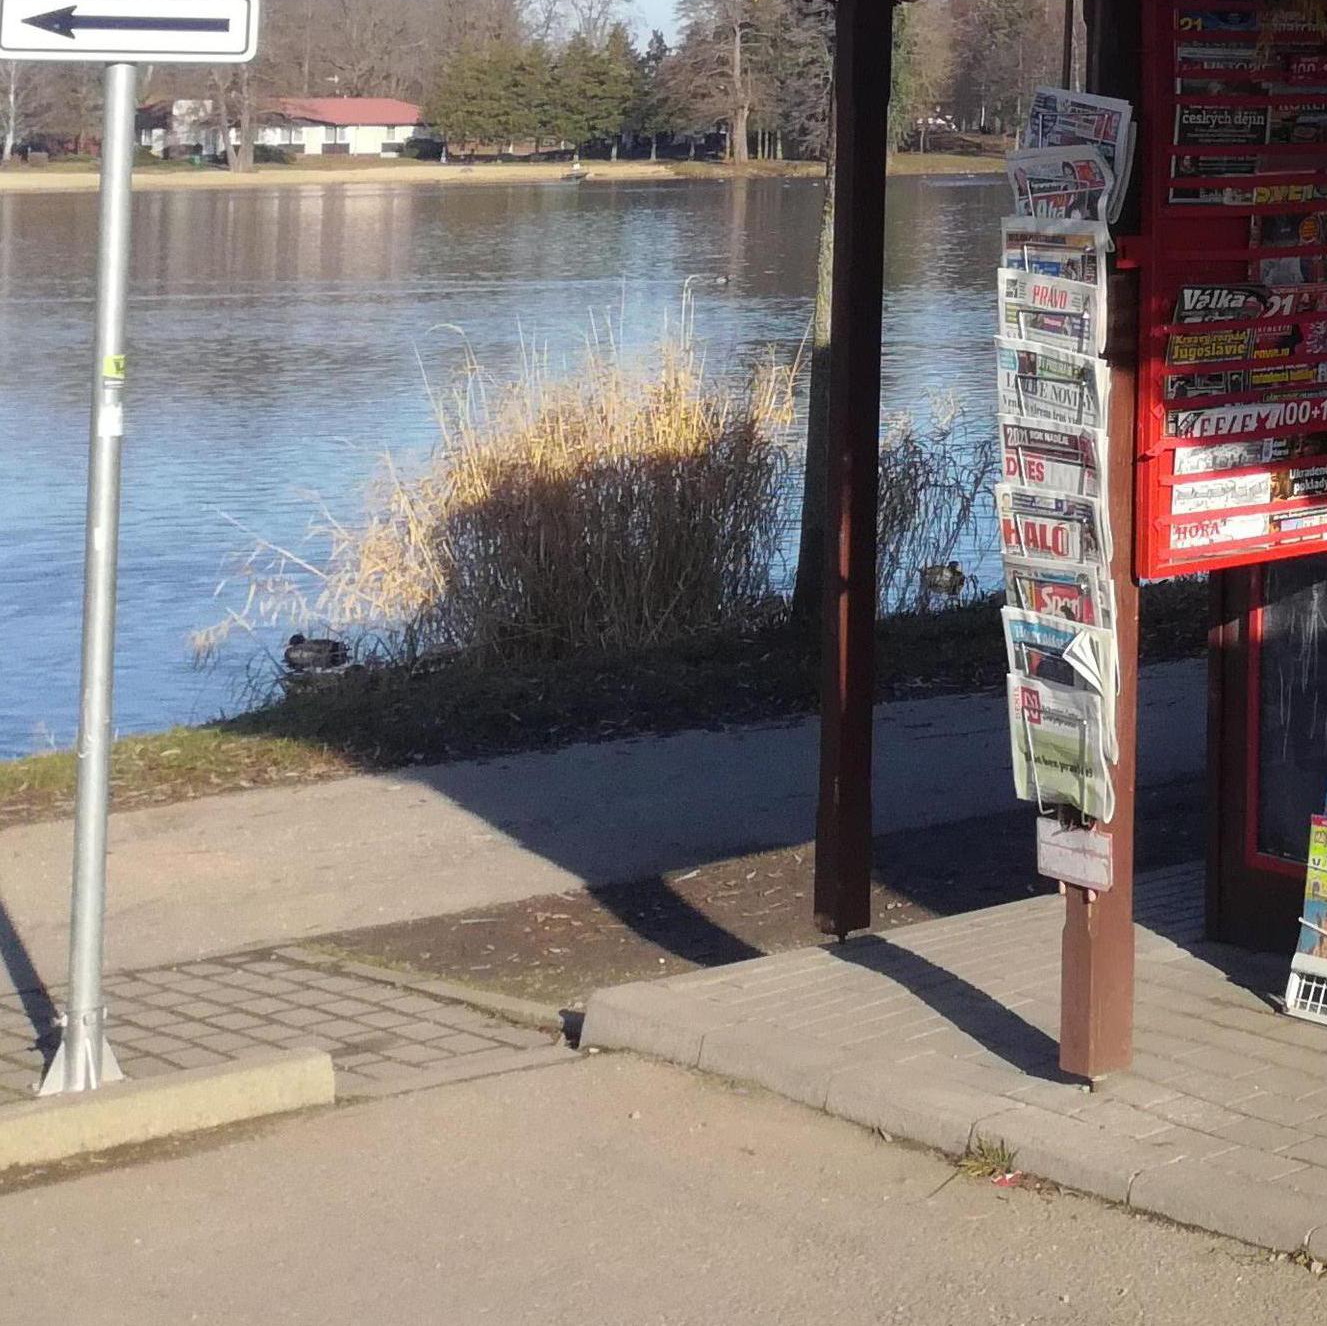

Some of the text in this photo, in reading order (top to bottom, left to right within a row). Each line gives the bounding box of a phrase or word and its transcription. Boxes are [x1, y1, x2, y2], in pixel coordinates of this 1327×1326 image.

[1182, 109, 1265, 128] českých dějin
[1032, 283, 1068, 311] PRÁVO
[1183, 288, 1244, 311] Válka
[1052, 384, 1094, 412] NOVIY
[1006, 456, 1045, 483] DES
[1002, 518, 1070, 558] HALÓ
